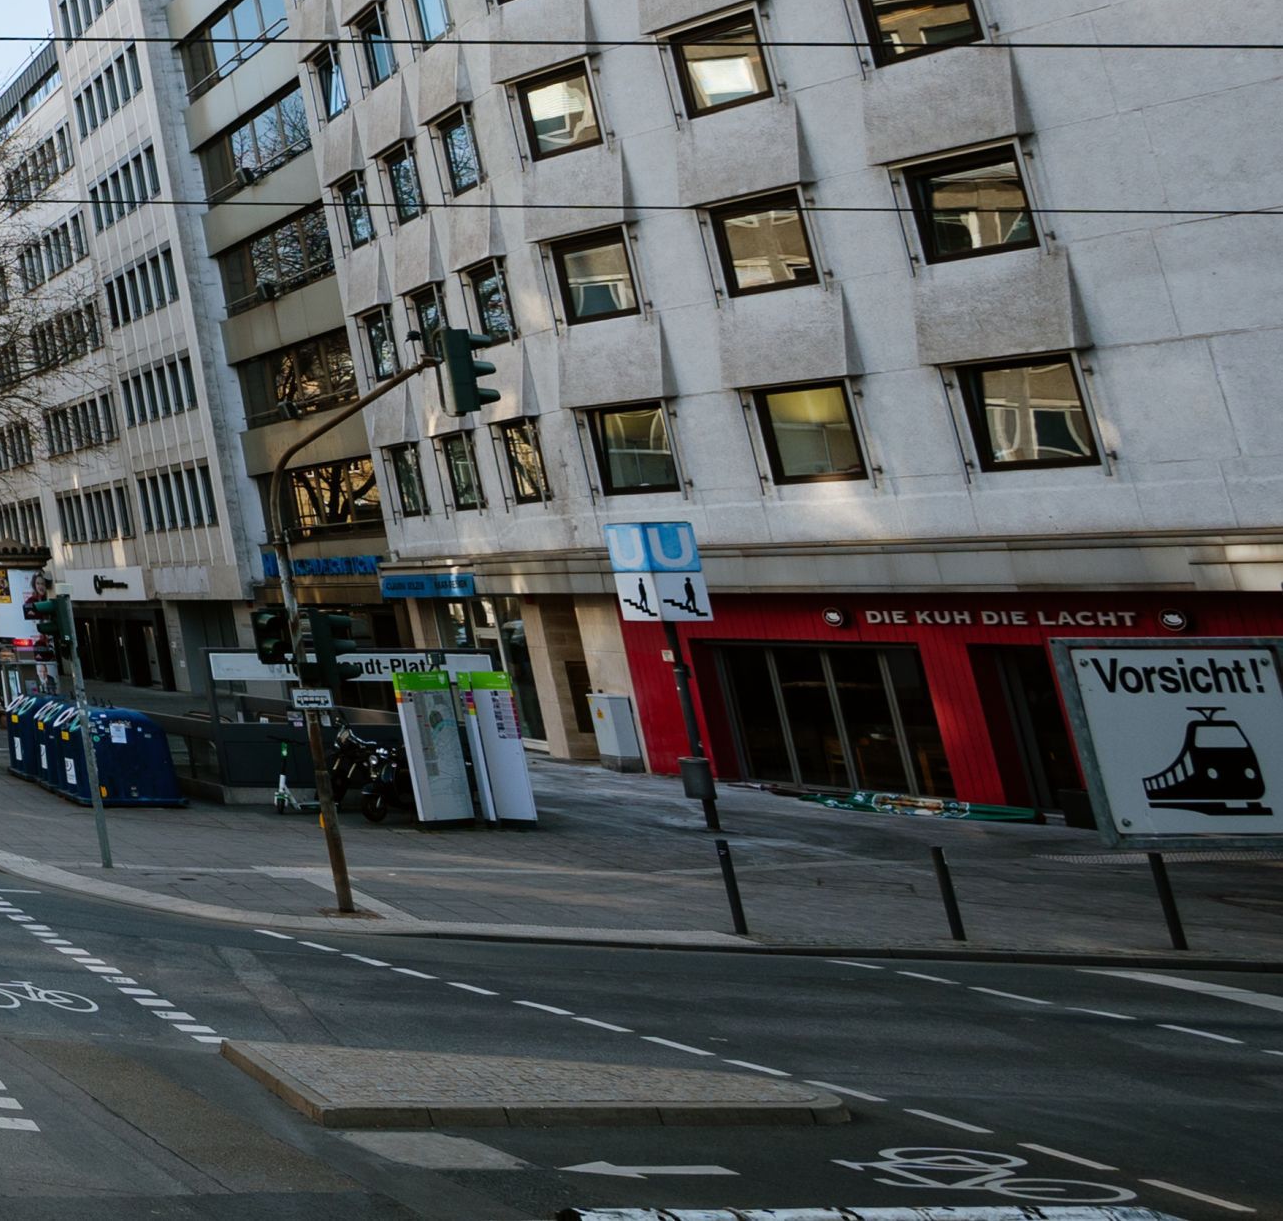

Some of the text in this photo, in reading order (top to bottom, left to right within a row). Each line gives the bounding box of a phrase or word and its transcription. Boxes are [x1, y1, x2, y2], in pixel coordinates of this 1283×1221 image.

[608, 528, 644, 567] U
[647, 527, 693, 567] U
[865, 610, 1136, 626] DIE KUH DIE LACHT
[1090, 658, 1265, 693] Vorsicht!
